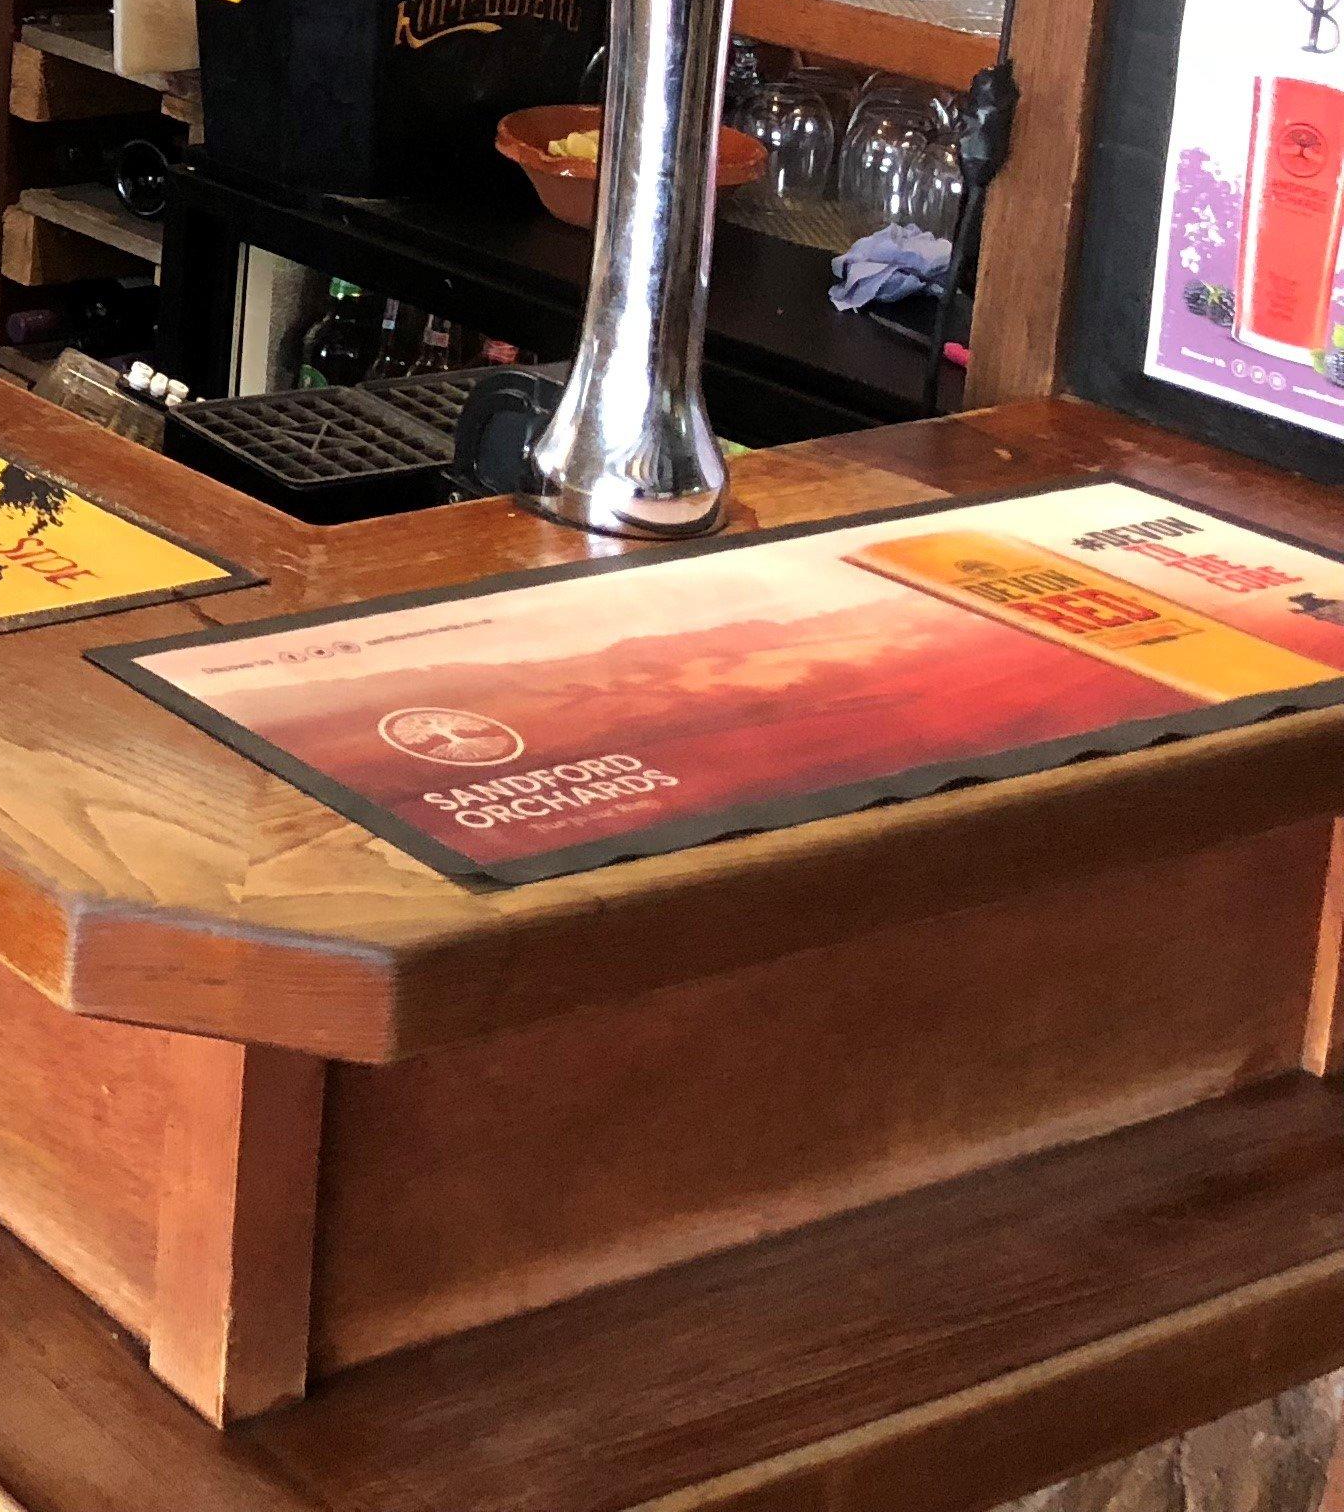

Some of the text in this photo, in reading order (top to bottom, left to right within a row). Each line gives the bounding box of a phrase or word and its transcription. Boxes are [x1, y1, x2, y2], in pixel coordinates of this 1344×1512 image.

[1072, 515, 1204, 552] #DEVON
[1122, 541, 1187, 562] TO
[1167, 554, 1247, 578] THE
[962, 569, 1088, 603] DEVON
[1207, 565, 1305, 594] CORE
[1009, 588, 1162, 634] RED
[423, 752, 643, 811] SANDFORD
[454, 768, 679, 829] ORCHARDS
